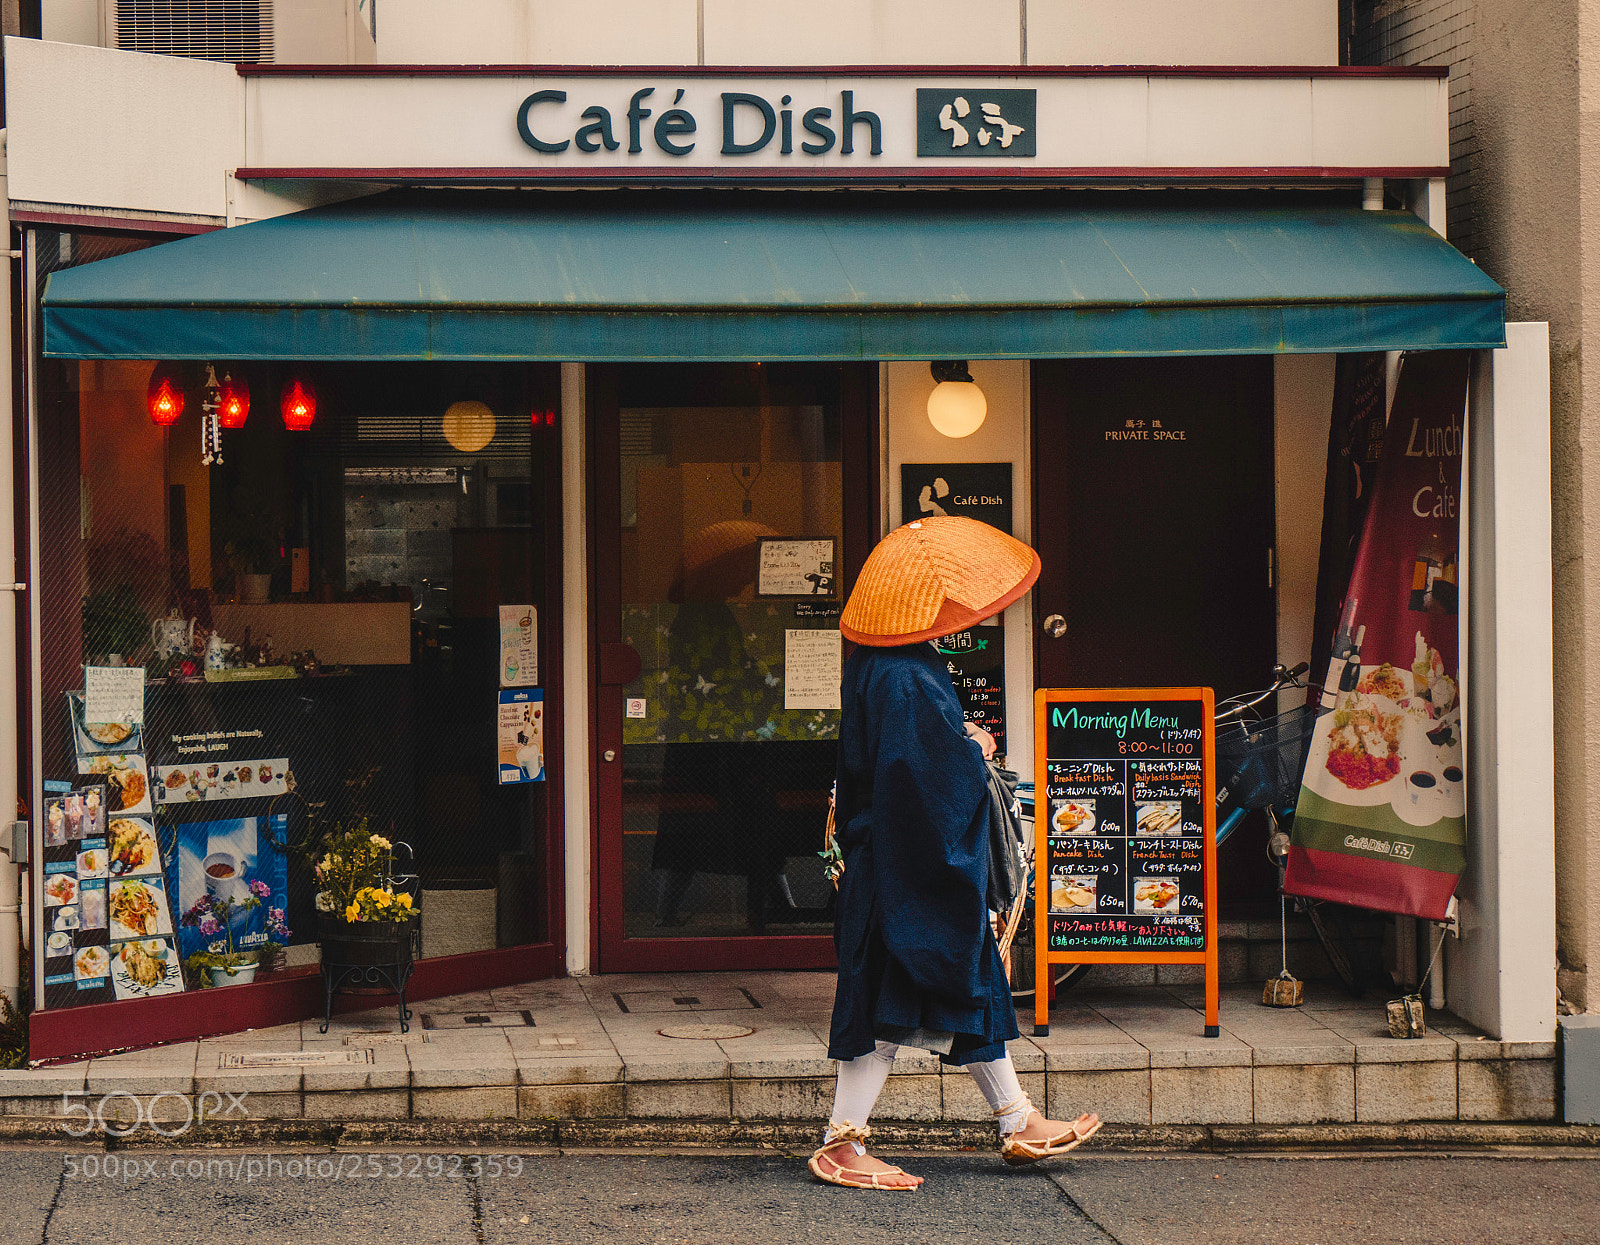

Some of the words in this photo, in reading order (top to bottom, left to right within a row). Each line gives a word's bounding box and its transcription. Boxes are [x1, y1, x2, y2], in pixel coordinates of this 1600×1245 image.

[516, 87, 698, 155] Café
[720, 89, 883, 155] Dish
[1105, 430, 1150, 440] PRIVATE
[1153, 430, 1187, 440] SPACE
[1405, 413, 1462, 458] Lunch
[953, 495, 978, 505] Café
[981, 495, 1003, 505] Dish
[1412, 485, 1456, 518] Café
[970, 693, 989, 701] 15:30
[1052, 707, 1129, 739] Morning
[208, 743, 229, 752] LAUGH
[1093, 773, 1114, 783] Dish
[1185, 779, 1202, 788] Dish
[1343, 834, 1370, 850] Café
[1367, 837, 1391, 854] Dish
[1087, 849, 1105, 858] Dish
[1181, 850, 1199, 859] Dish
